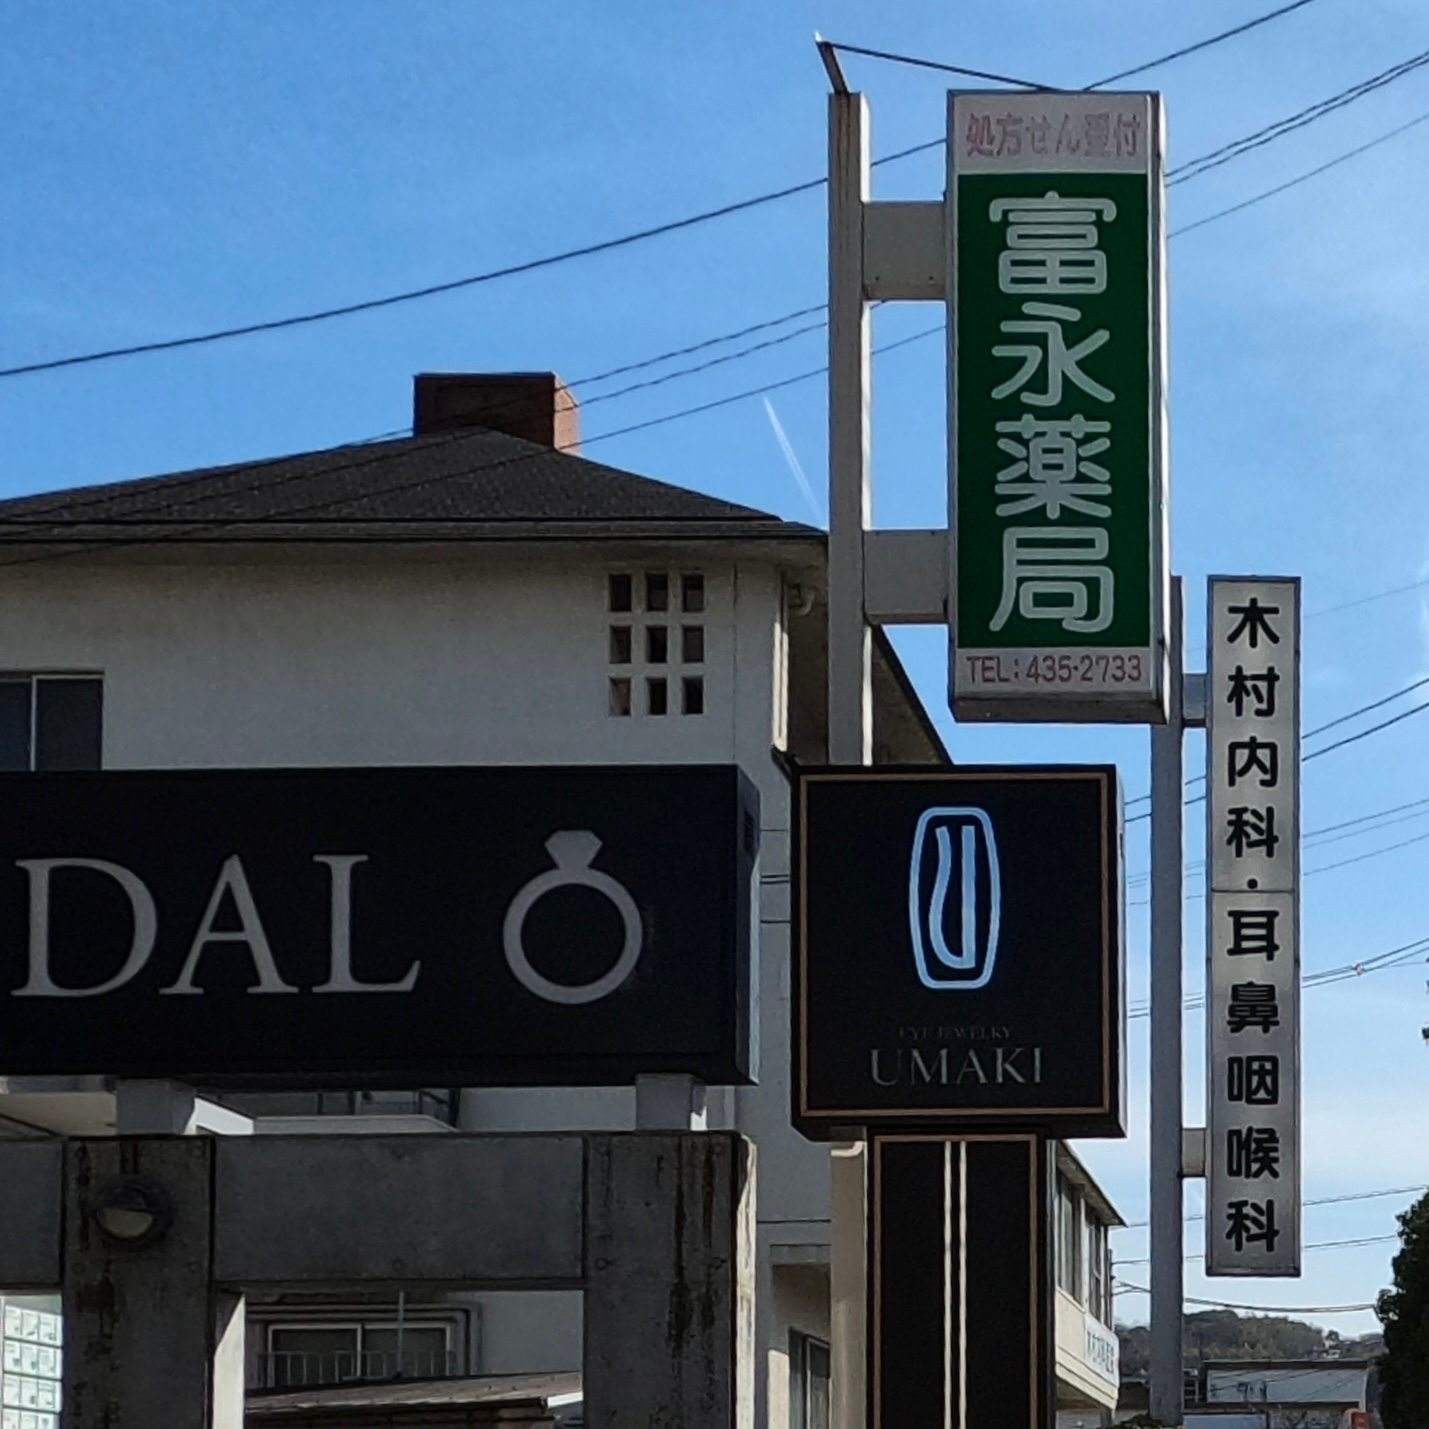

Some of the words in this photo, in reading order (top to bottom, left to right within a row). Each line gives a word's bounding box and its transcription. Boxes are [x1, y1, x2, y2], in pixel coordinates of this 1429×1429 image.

[966, 112, 1144, 158] 処方せん受付
[988, 190, 1117, 632] 富永薬局
[10, 854, 422, 997] DAL
[1225, 597, 1280, 1253] 木村内科・耳鼻咽喉科
[869, 1047, 1044, 1087] UMAKI
